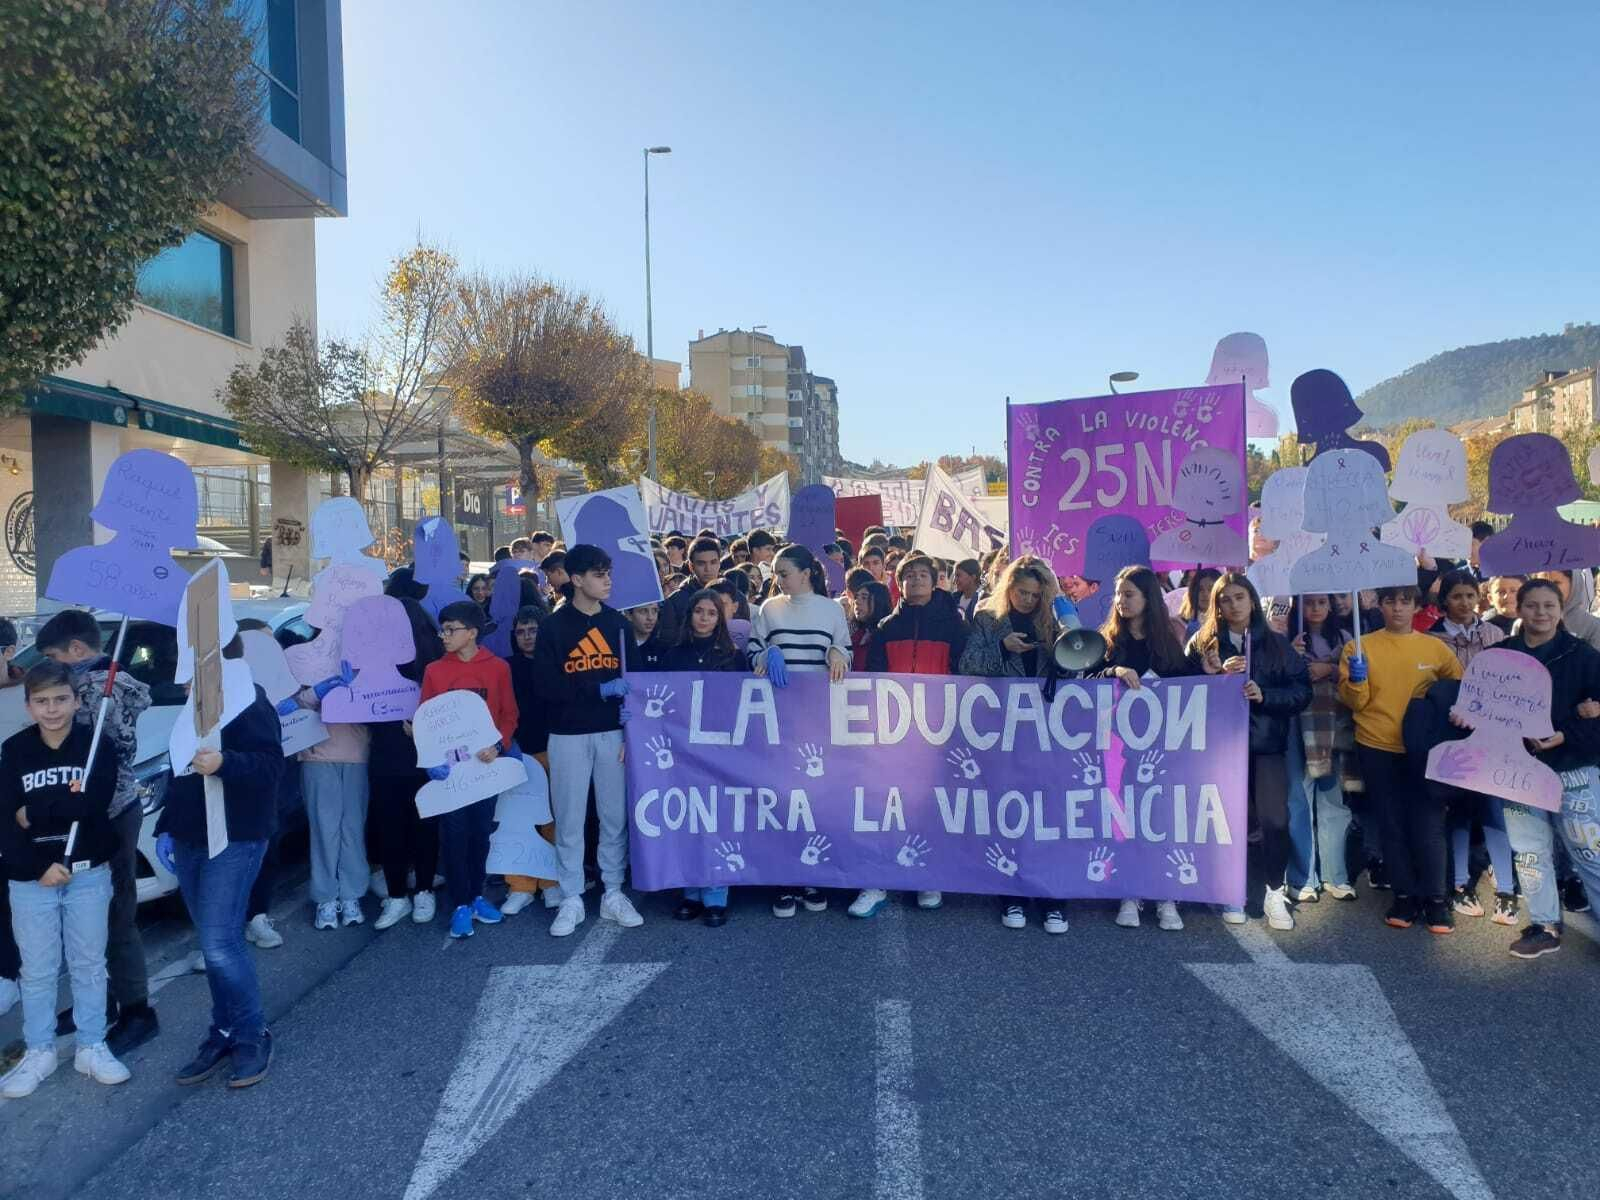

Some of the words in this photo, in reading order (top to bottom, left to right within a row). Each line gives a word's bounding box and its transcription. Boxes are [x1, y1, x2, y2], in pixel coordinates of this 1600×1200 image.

[1022, 427, 1061, 507] CONTRA
[1081, 410, 1109, 433] LA
[1059, 439, 1174, 512] 25N
[649, 502, 782, 536] VALIENTES
[564, 653, 619, 674] adidas
[689, 678, 780, 745] LA
[635, 785, 816, 837] CONTRA
[854, 786, 906, 832] LA
[934, 784, 1232, 845] VIOLENCIA
